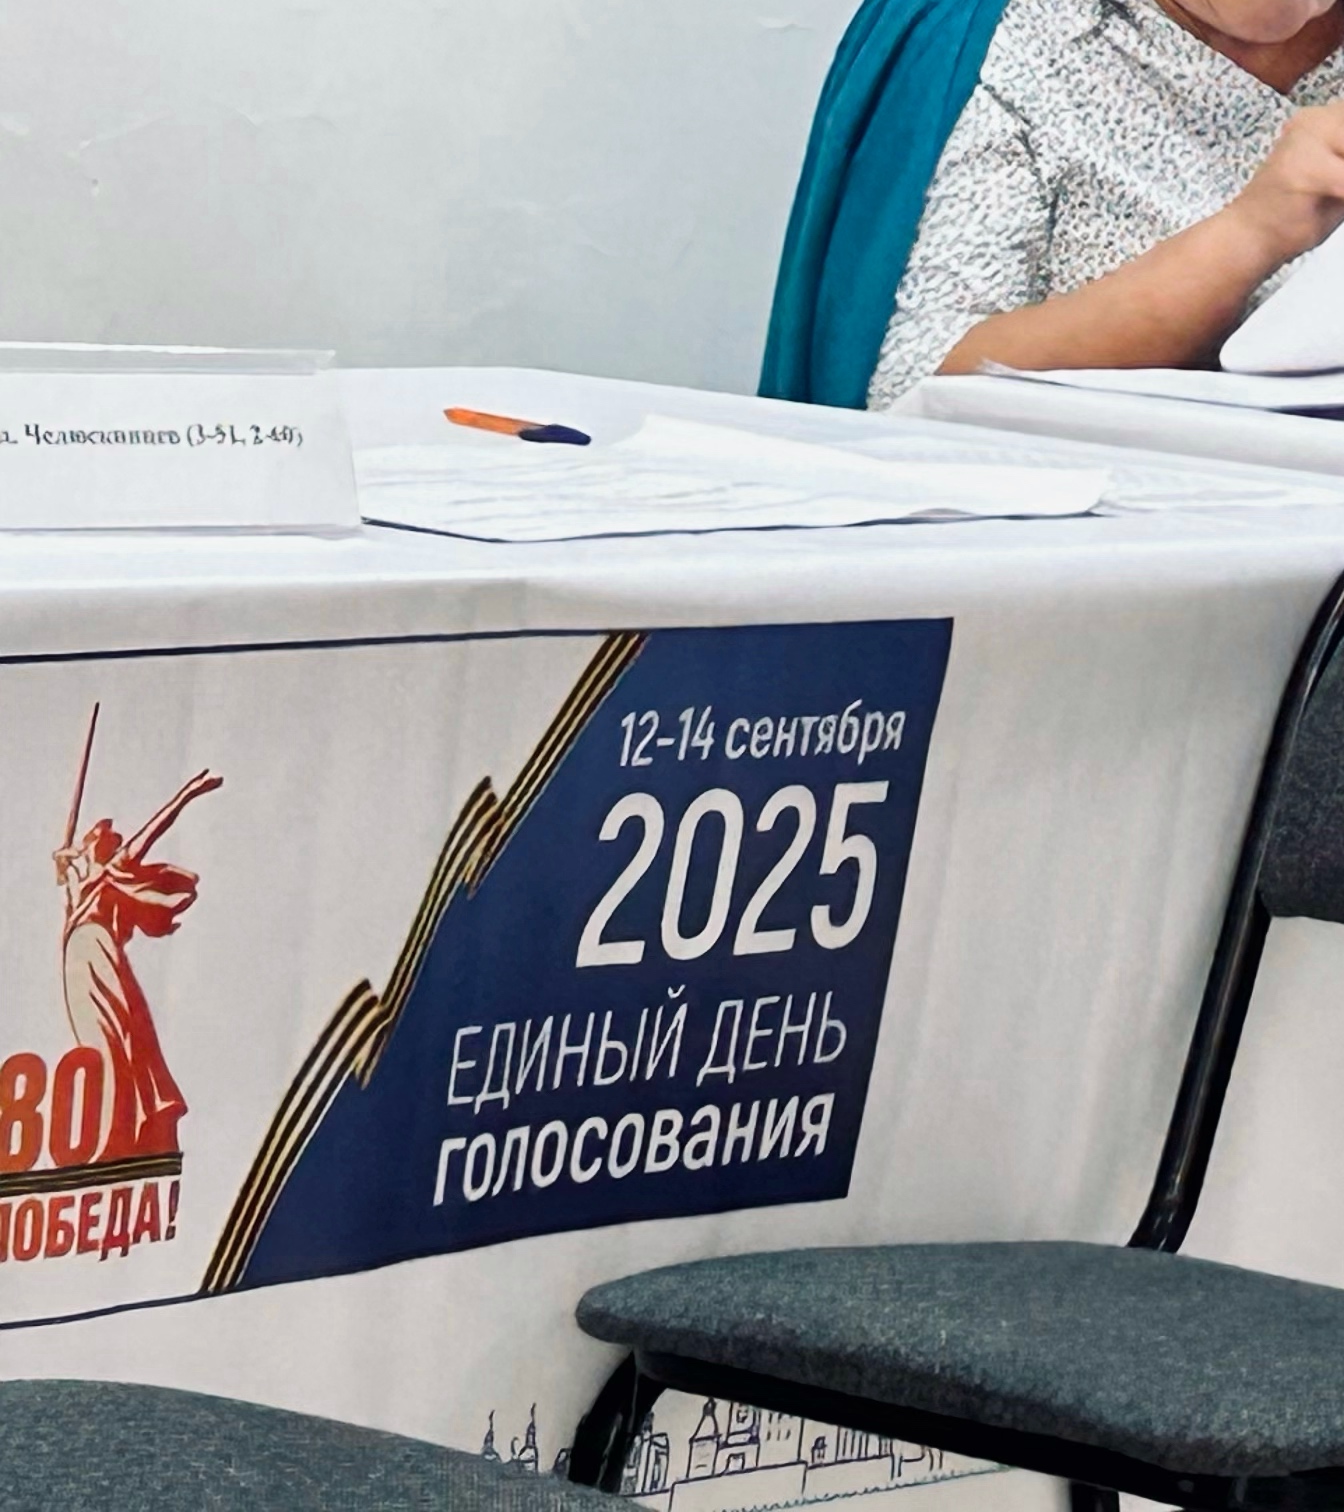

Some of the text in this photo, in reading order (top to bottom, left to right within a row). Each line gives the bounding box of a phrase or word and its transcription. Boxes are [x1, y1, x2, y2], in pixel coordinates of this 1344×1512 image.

[619, 699, 906, 767] 12-14 сентября
[575, 780, 889, 968] 2025
[0, 1047, 104, 1173] 80
[447, 985, 847, 1114] ЕДИНЫЙ ДЕНЬ
